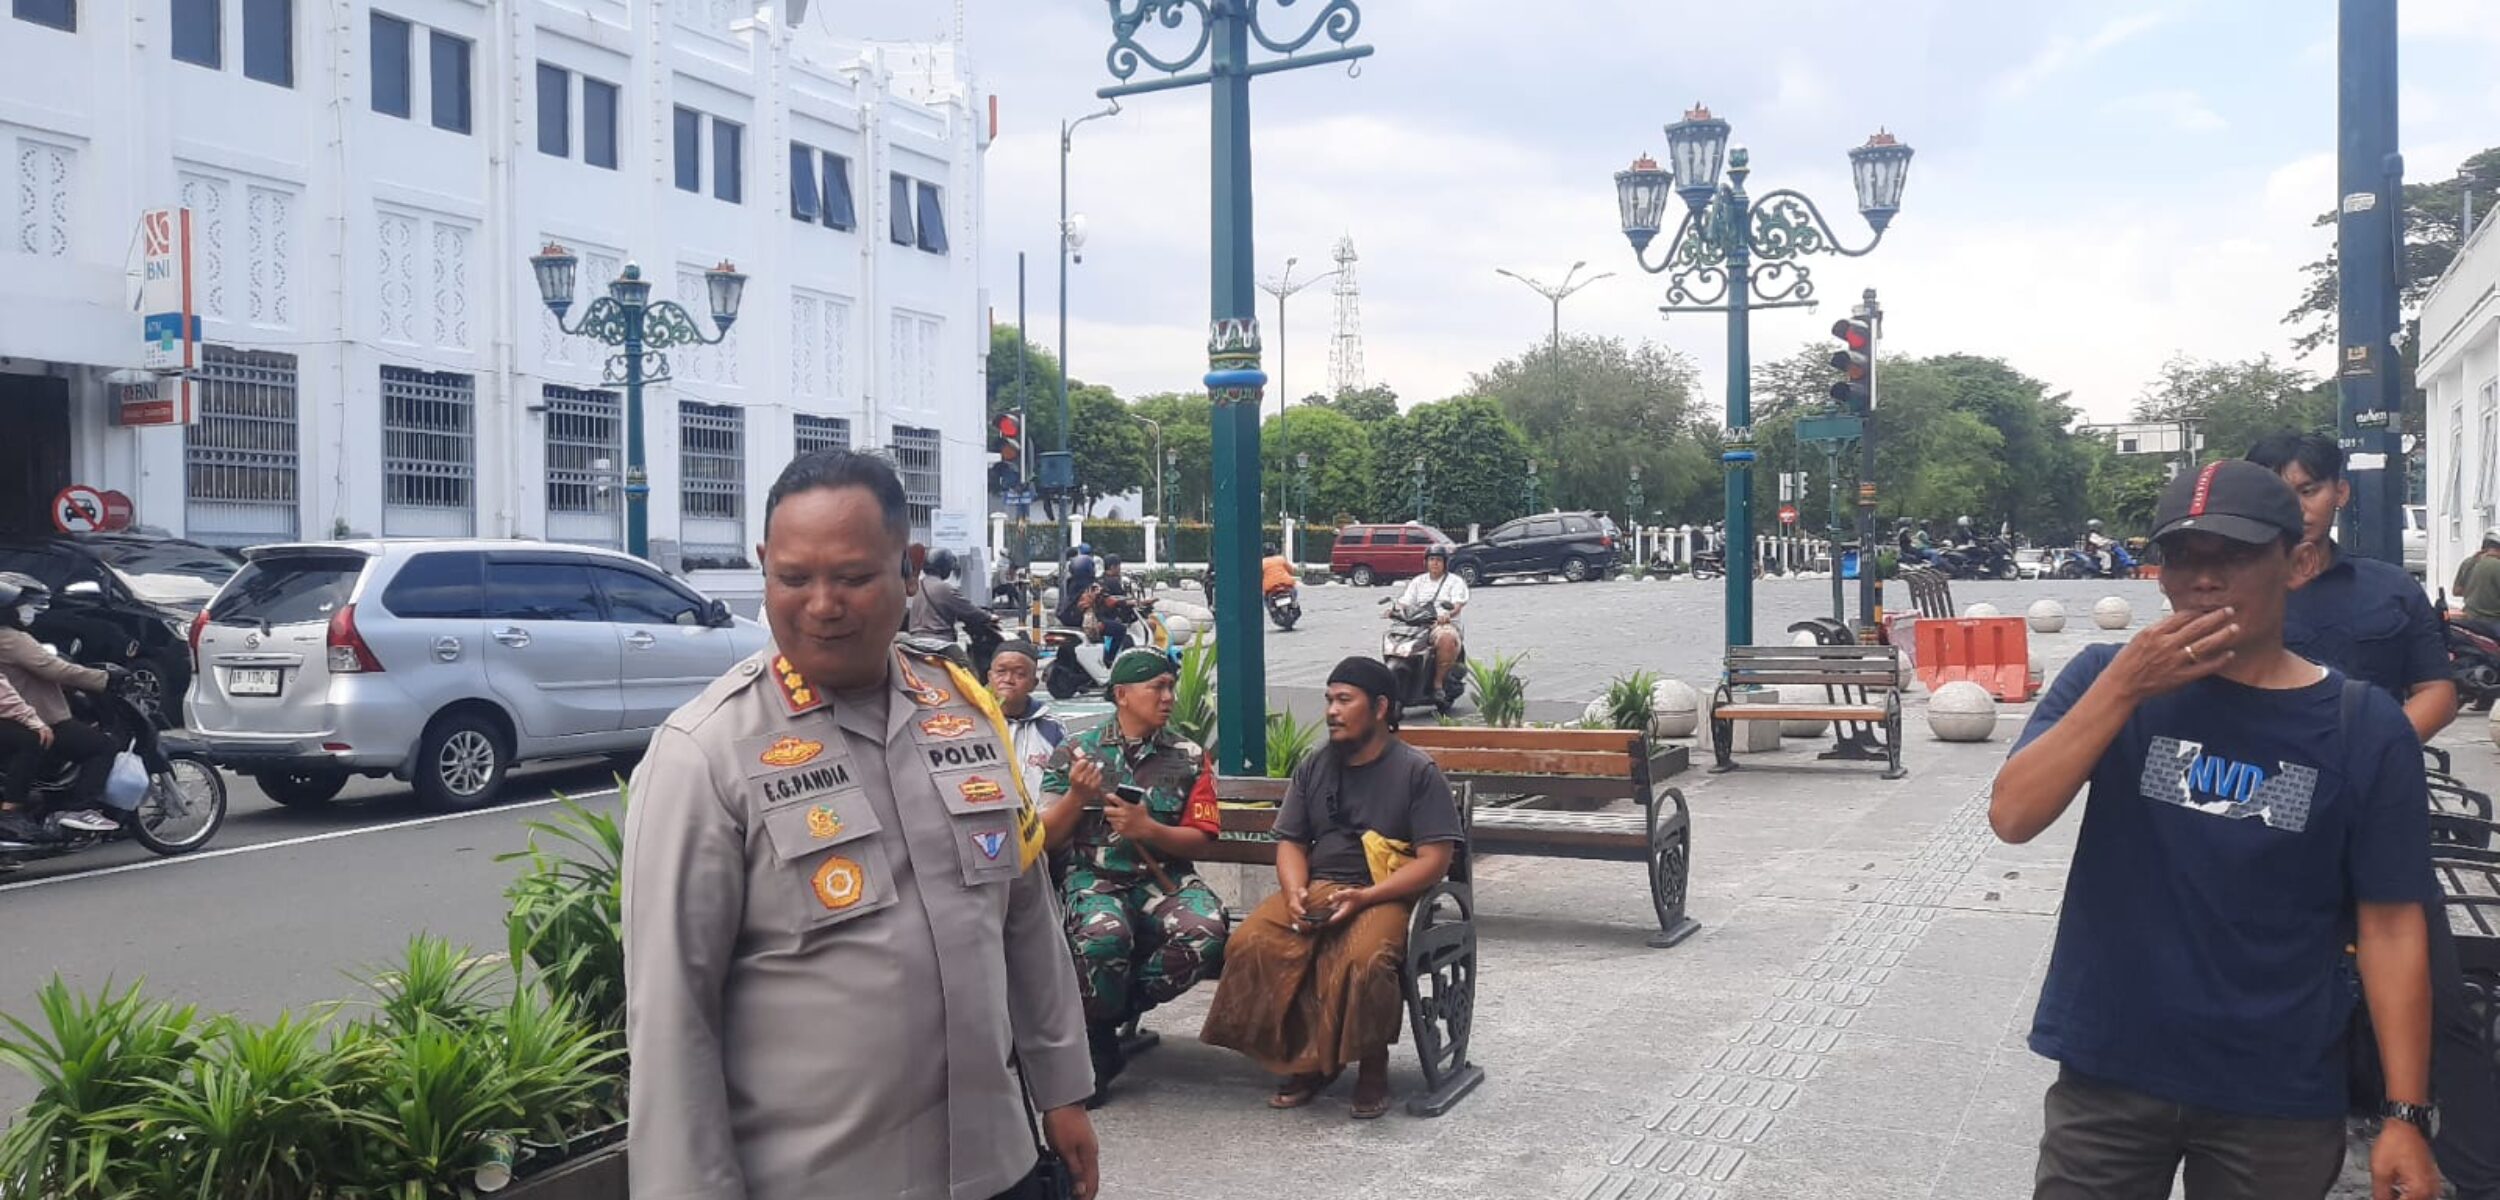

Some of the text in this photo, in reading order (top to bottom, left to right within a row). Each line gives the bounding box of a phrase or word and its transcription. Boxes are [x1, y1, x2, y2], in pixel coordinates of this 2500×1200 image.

[147, 259, 170, 280] BNI
[135, 383, 158, 401] BNI
[928, 743, 998, 767] POLRI
[763, 763, 850, 803] E.G.PANDIA
[2187, 755, 2264, 803] NVD
